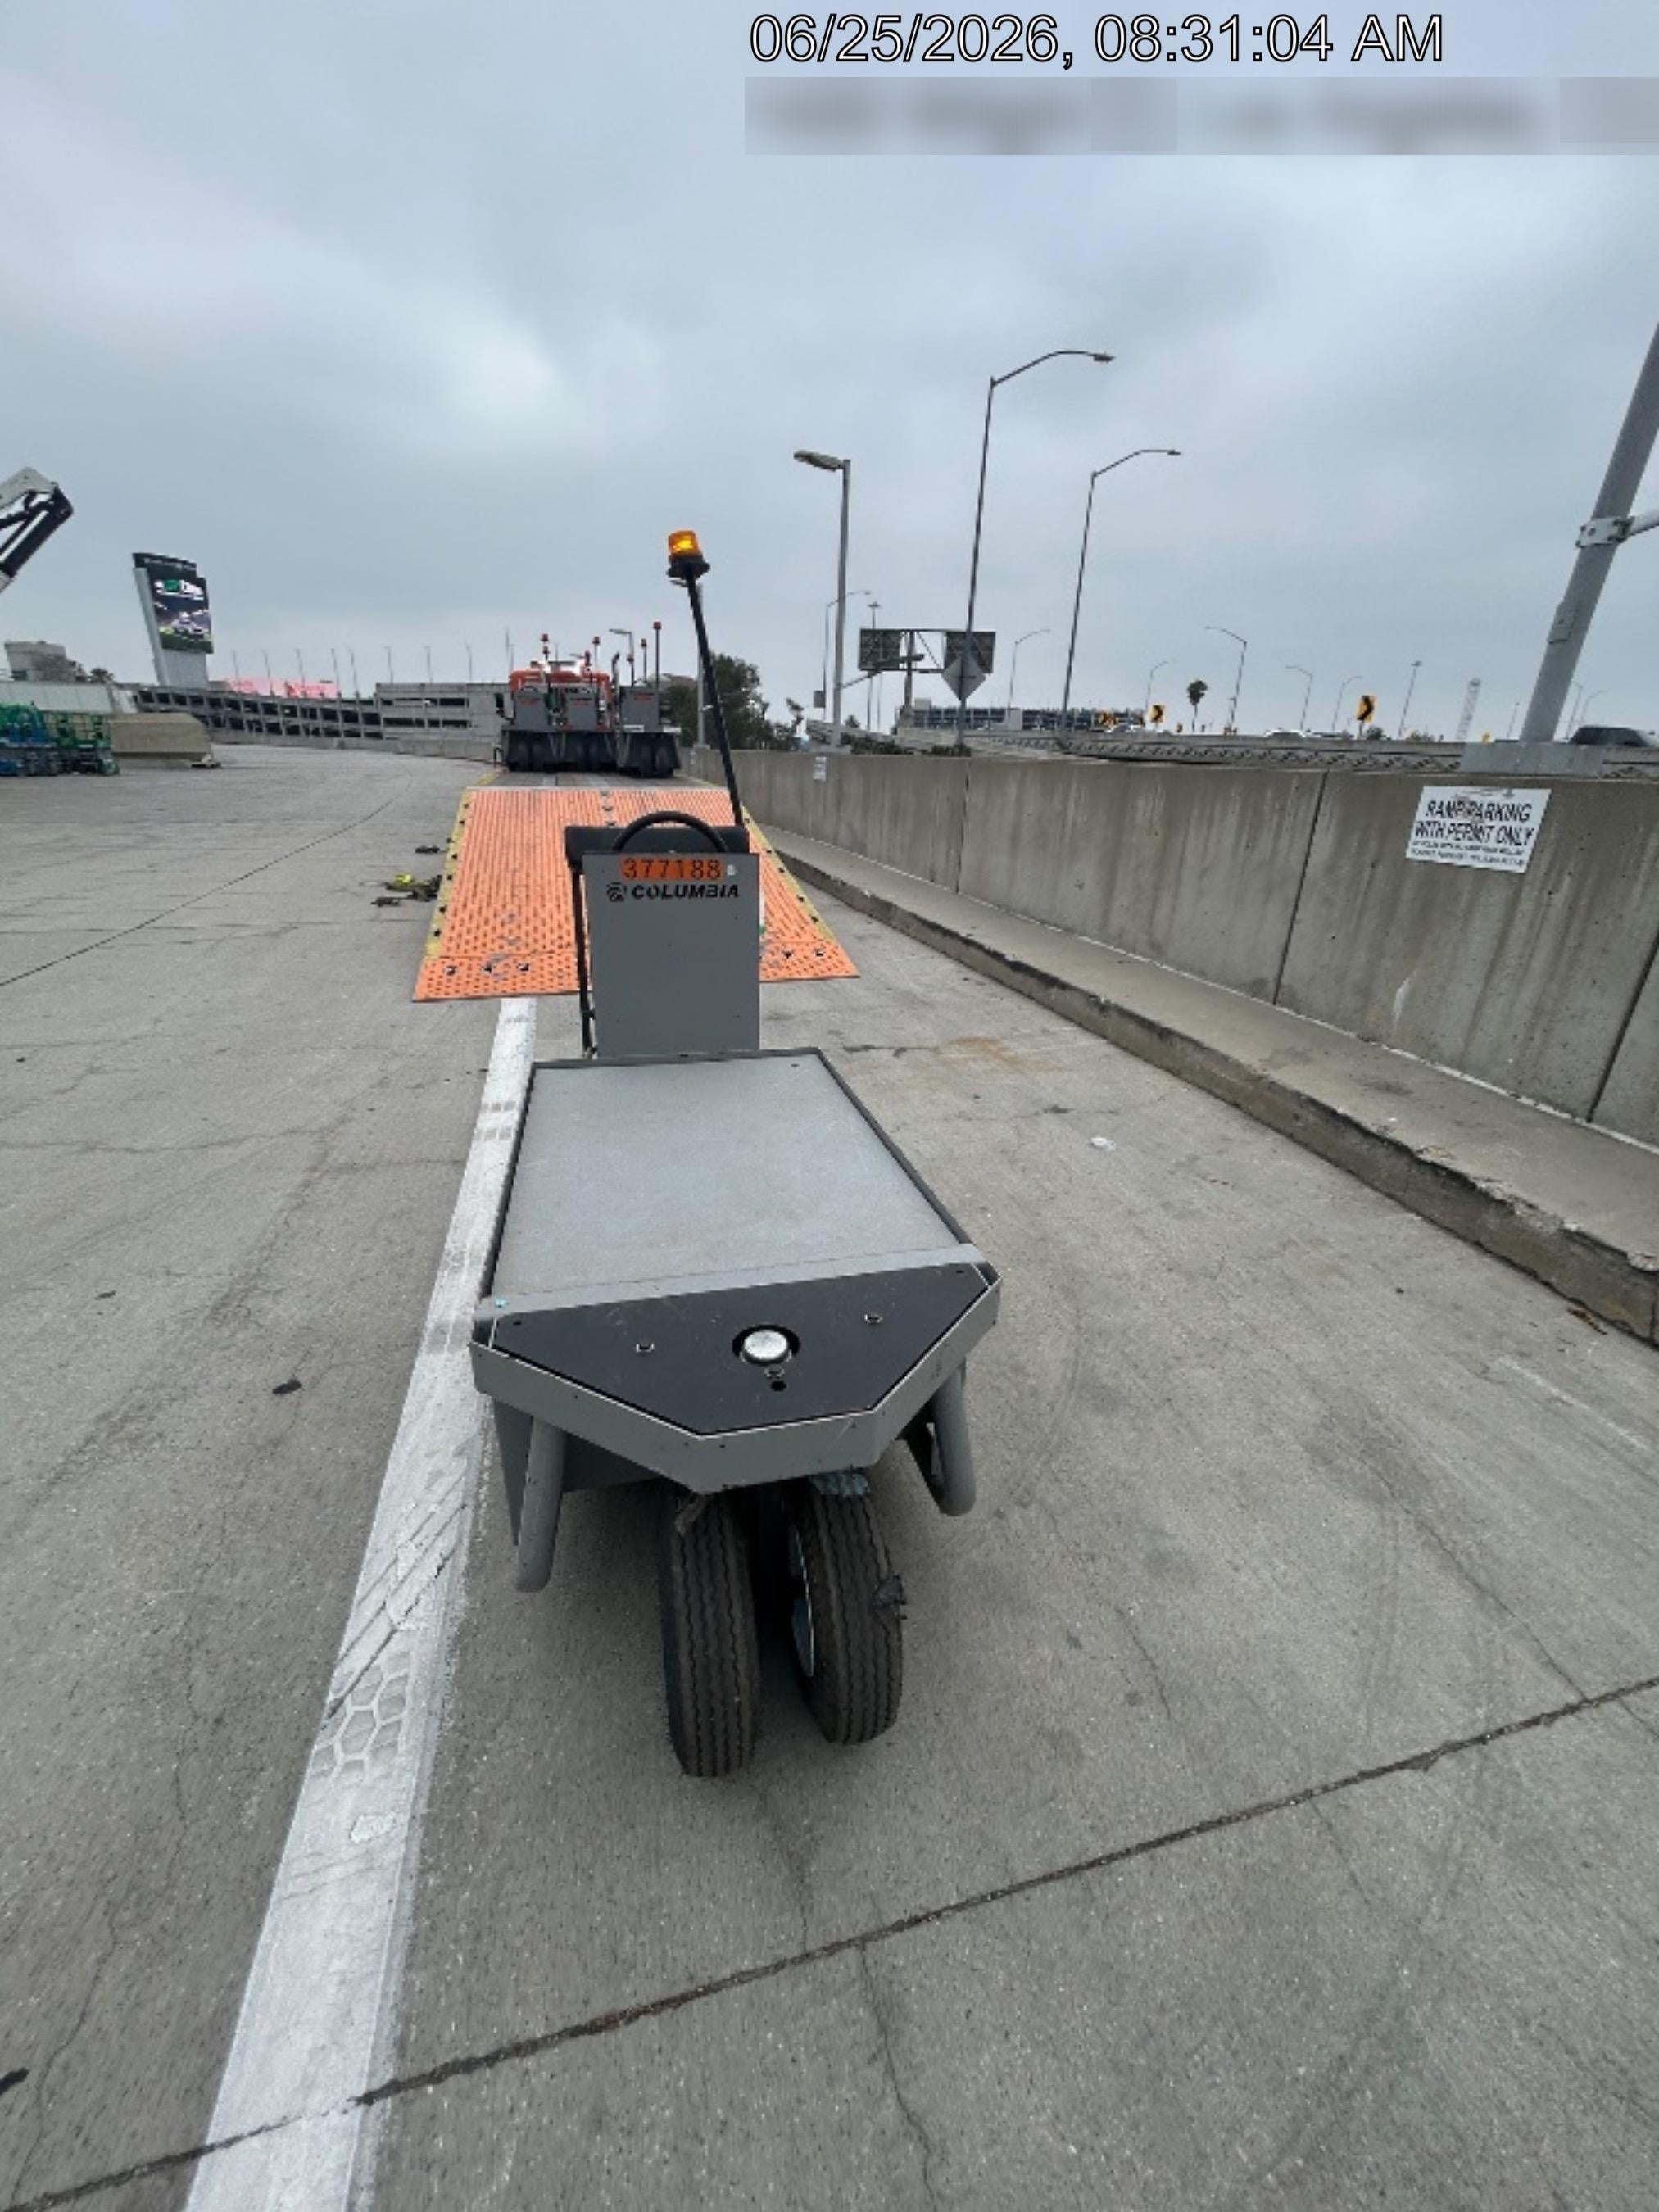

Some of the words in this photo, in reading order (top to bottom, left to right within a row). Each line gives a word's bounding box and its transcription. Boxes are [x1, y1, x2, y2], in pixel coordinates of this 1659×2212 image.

[1426, 800, 1464, 818] RAMP
[1465, 801, 1533, 823] PARKING
[1415, 820, 1444, 839] WITH
[1445, 821, 1495, 844] PERMIT
[1496, 825, 1534, 846] ONLY
[623, 857, 721, 881] 377188
[631, 884, 740, 900] COLUMBIA
